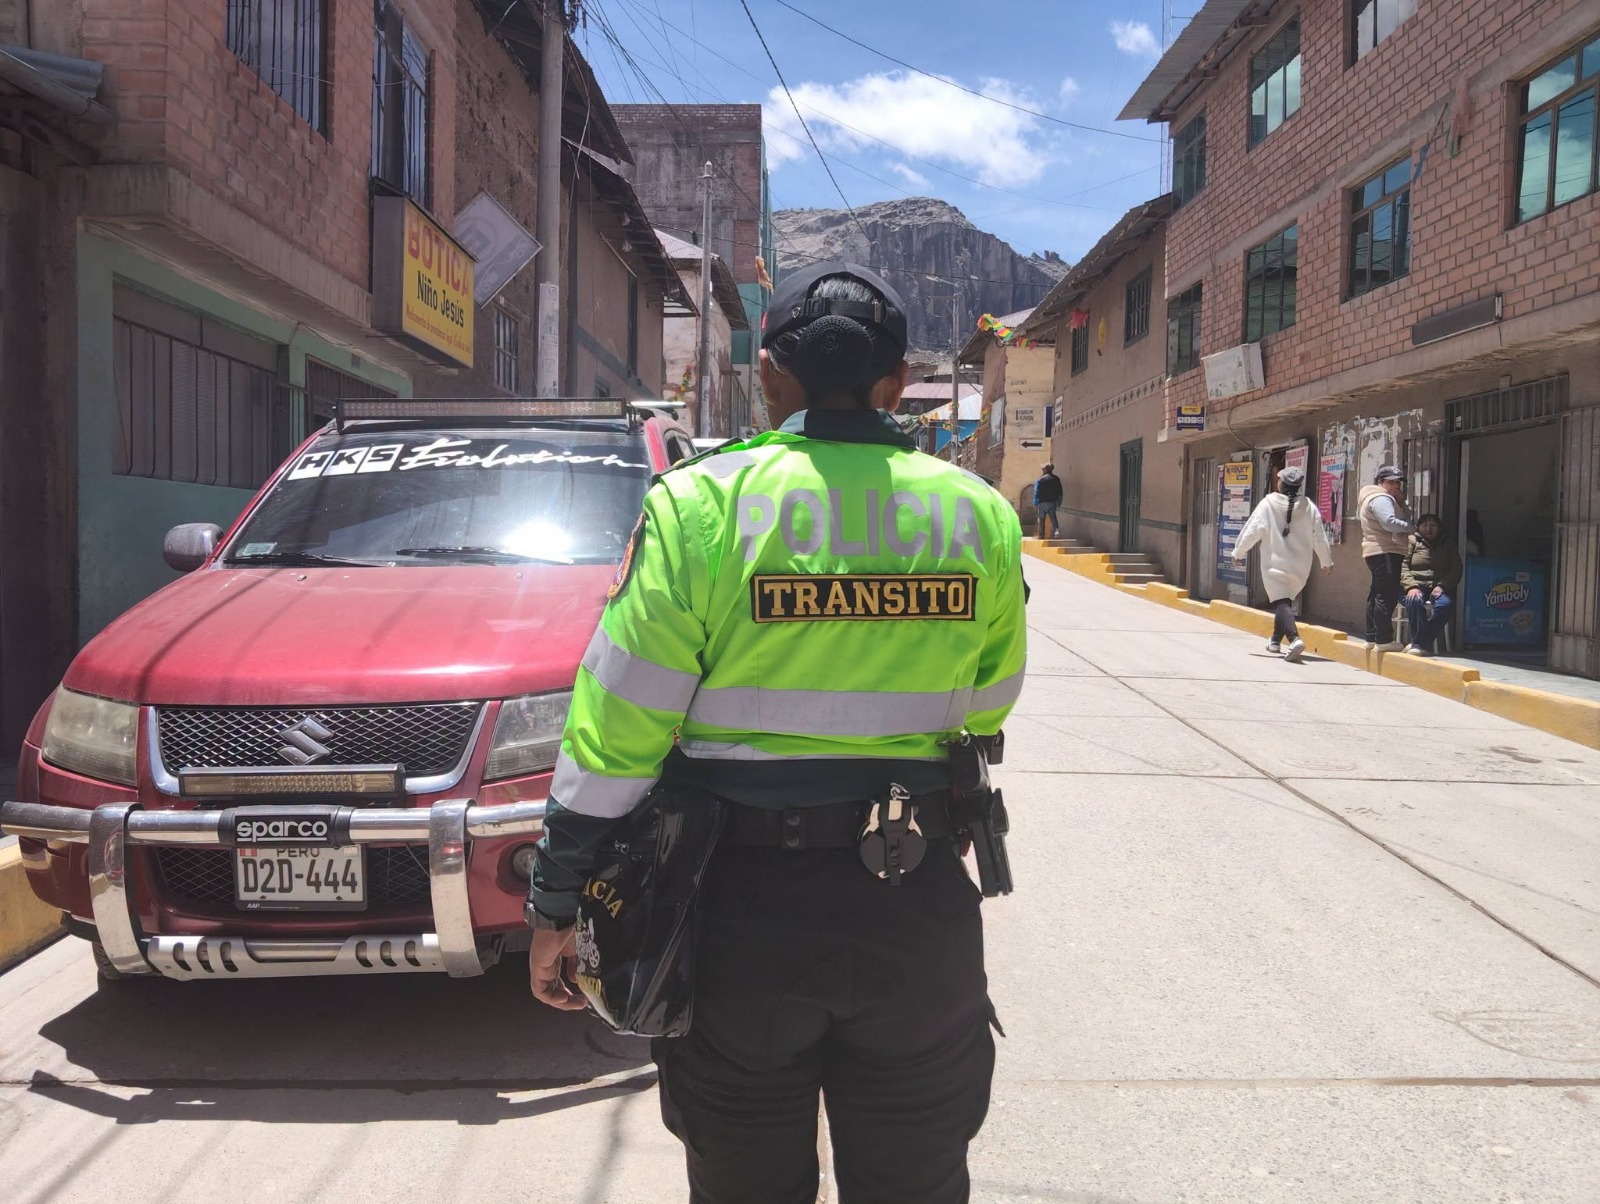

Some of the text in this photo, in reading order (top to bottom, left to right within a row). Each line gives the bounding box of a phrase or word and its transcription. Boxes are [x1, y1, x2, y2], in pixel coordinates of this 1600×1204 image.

[408, 212, 470, 297] BOTICA
[417, 270, 438, 310] Niño
[441, 288, 464, 328] Jesús
[291, 438, 648, 479] HKS Evolution
[735, 488, 985, 563] POLICIA
[763, 580, 966, 615] TRANSITO
[236, 820, 328, 842] sparco
[241, 858, 358, 893] D2D-444
